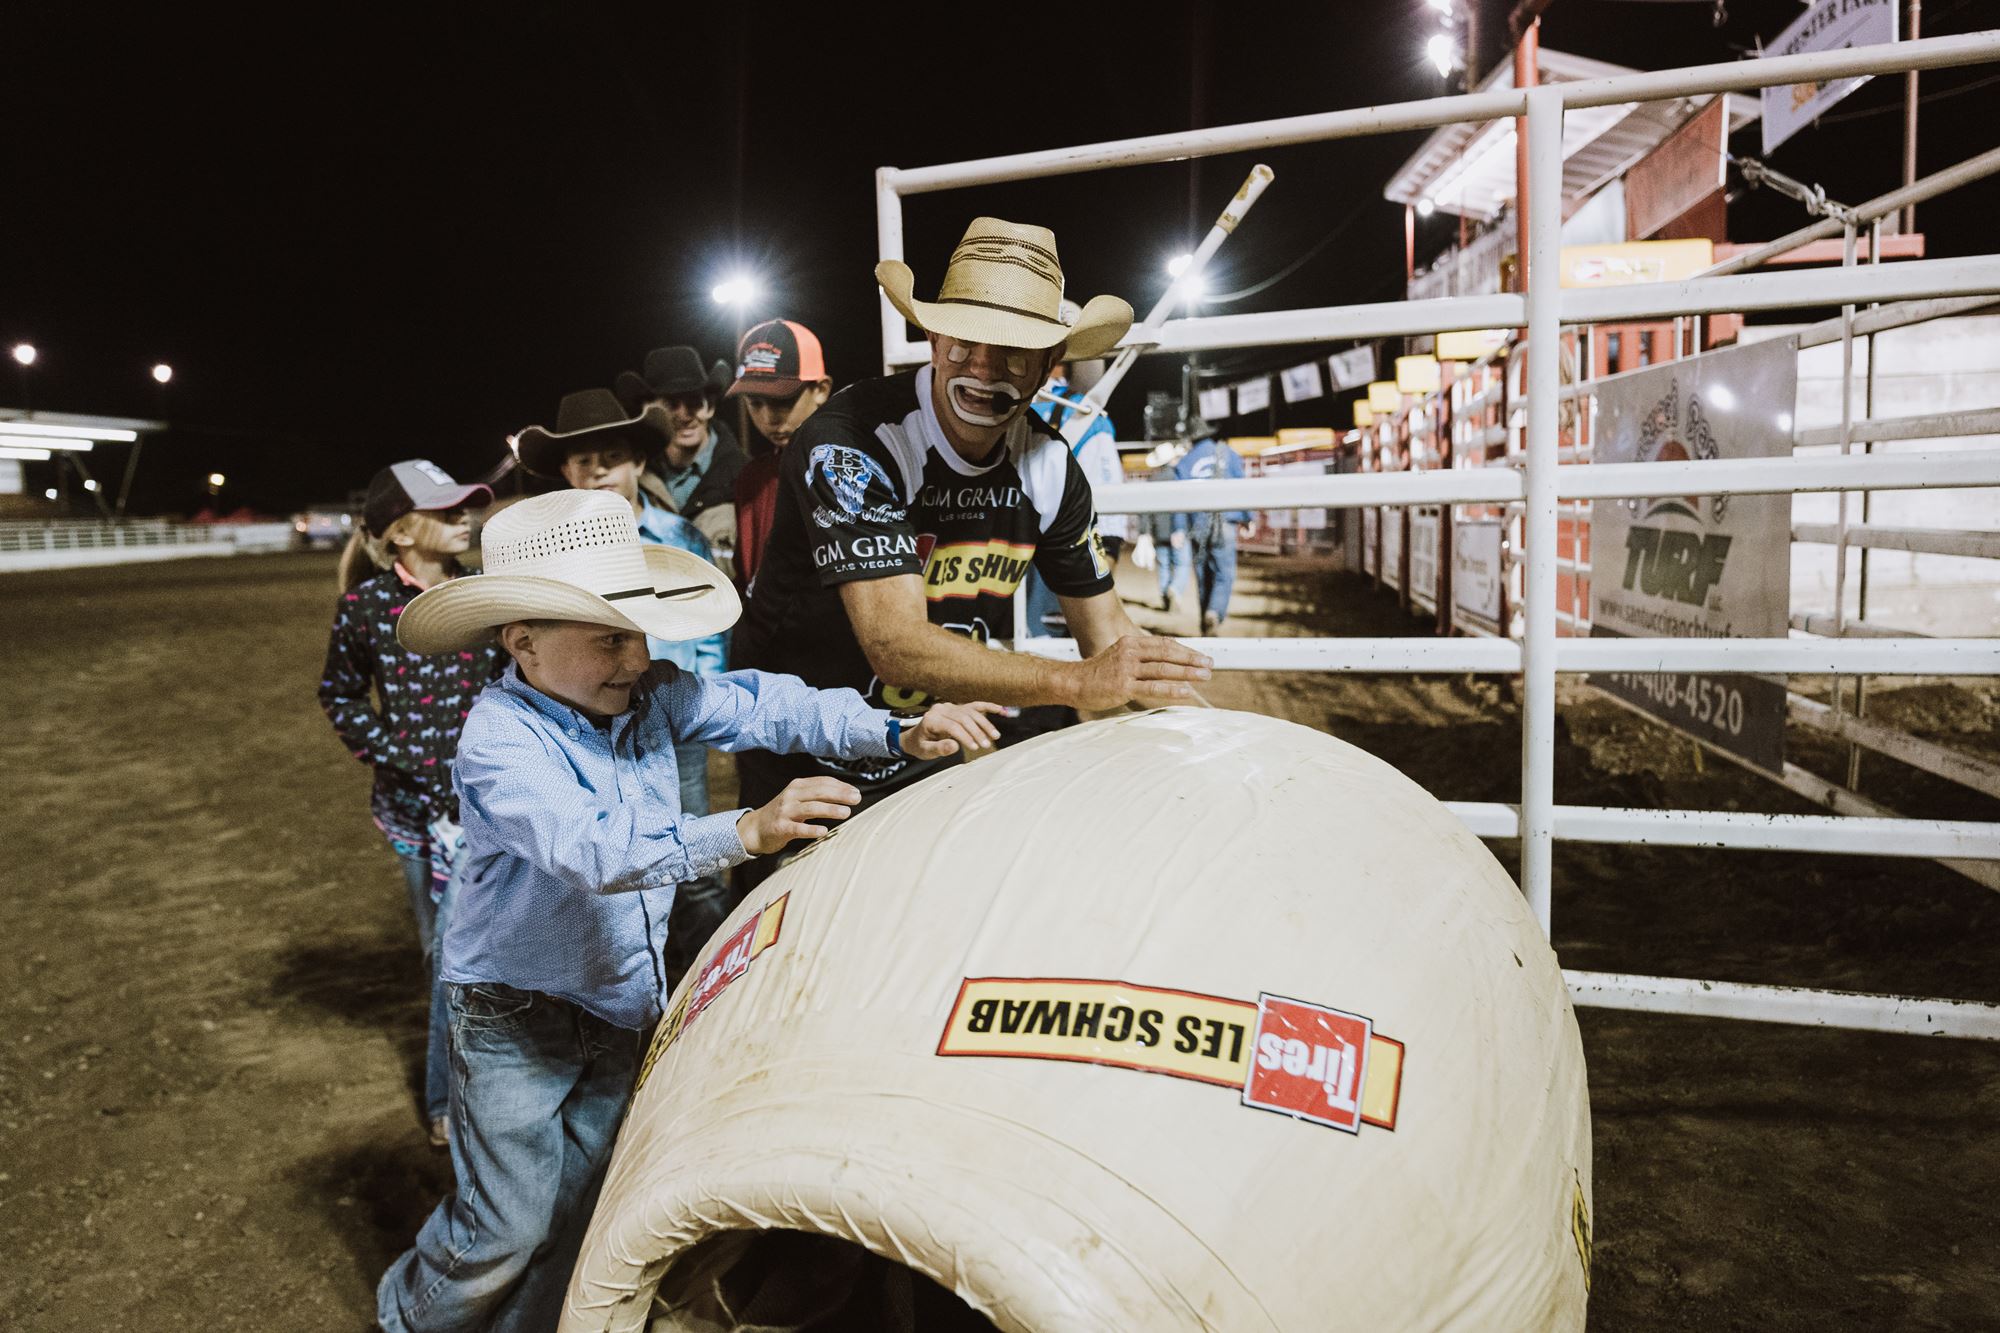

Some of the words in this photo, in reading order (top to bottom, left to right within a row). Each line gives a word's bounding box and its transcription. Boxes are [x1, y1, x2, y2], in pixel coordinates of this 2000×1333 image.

[834, 563, 857, 573] LAS
[859, 558, 903, 569] VEGAS
[1621, 525, 1733, 608] TURF
[966, 998, 1164, 1048] SCHWAB
[1174, 1015, 1245, 1063] LES
[1257, 1031, 1358, 1112] Tires
